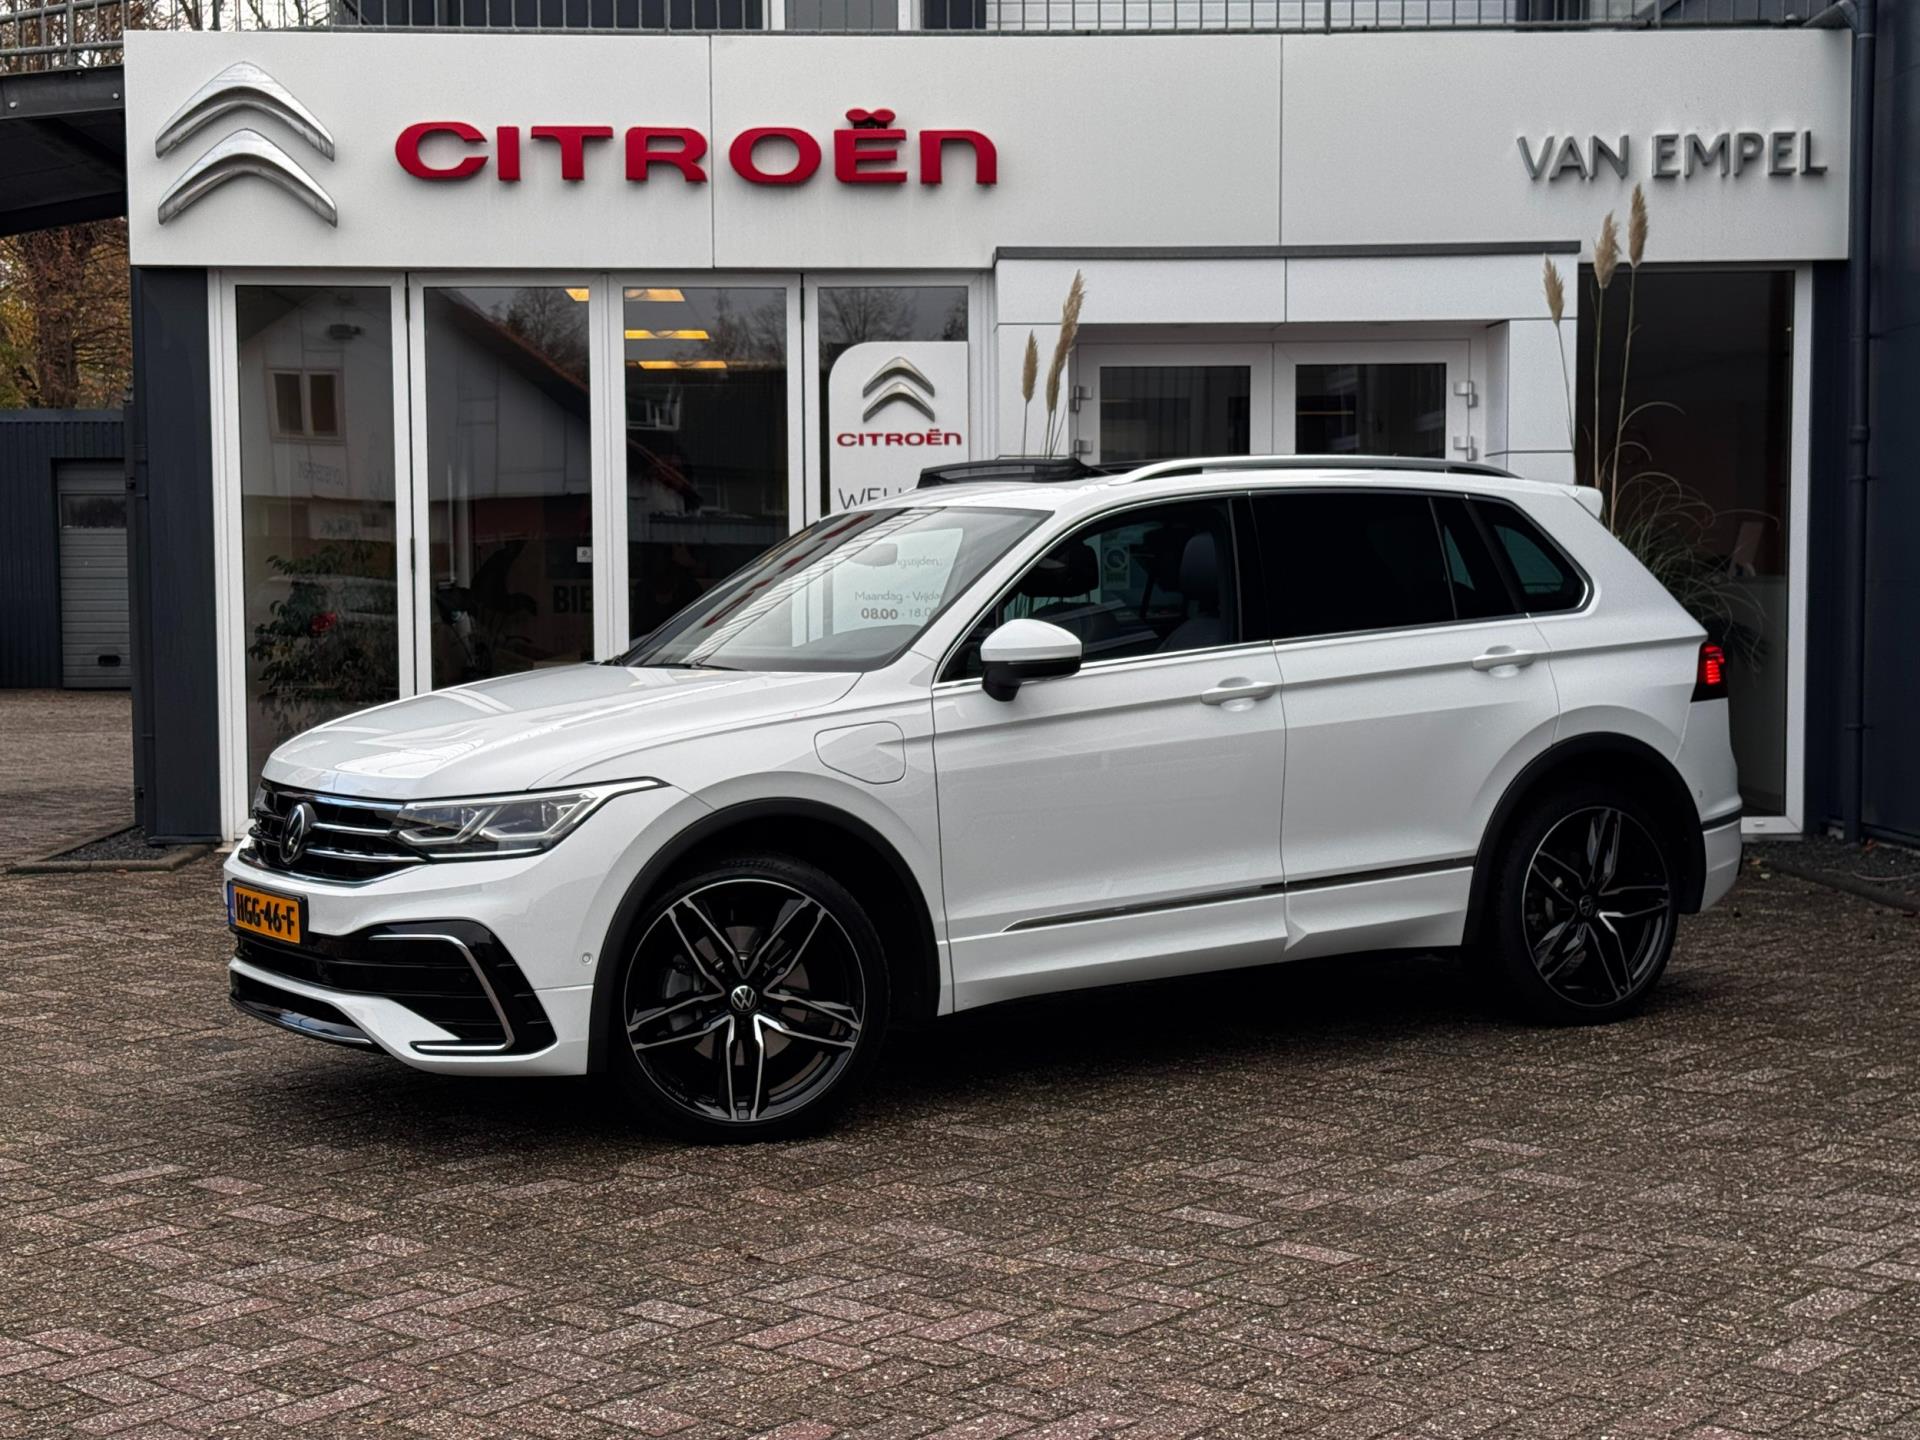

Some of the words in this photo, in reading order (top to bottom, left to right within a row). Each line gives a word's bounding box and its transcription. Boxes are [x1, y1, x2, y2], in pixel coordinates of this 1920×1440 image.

[1516, 134, 1630, 181] VAN
[1651, 130, 1828, 178] EMPEL
[860, 608, 898, 620] 08.00
[235, 892, 295, 936] HGG-46-F
